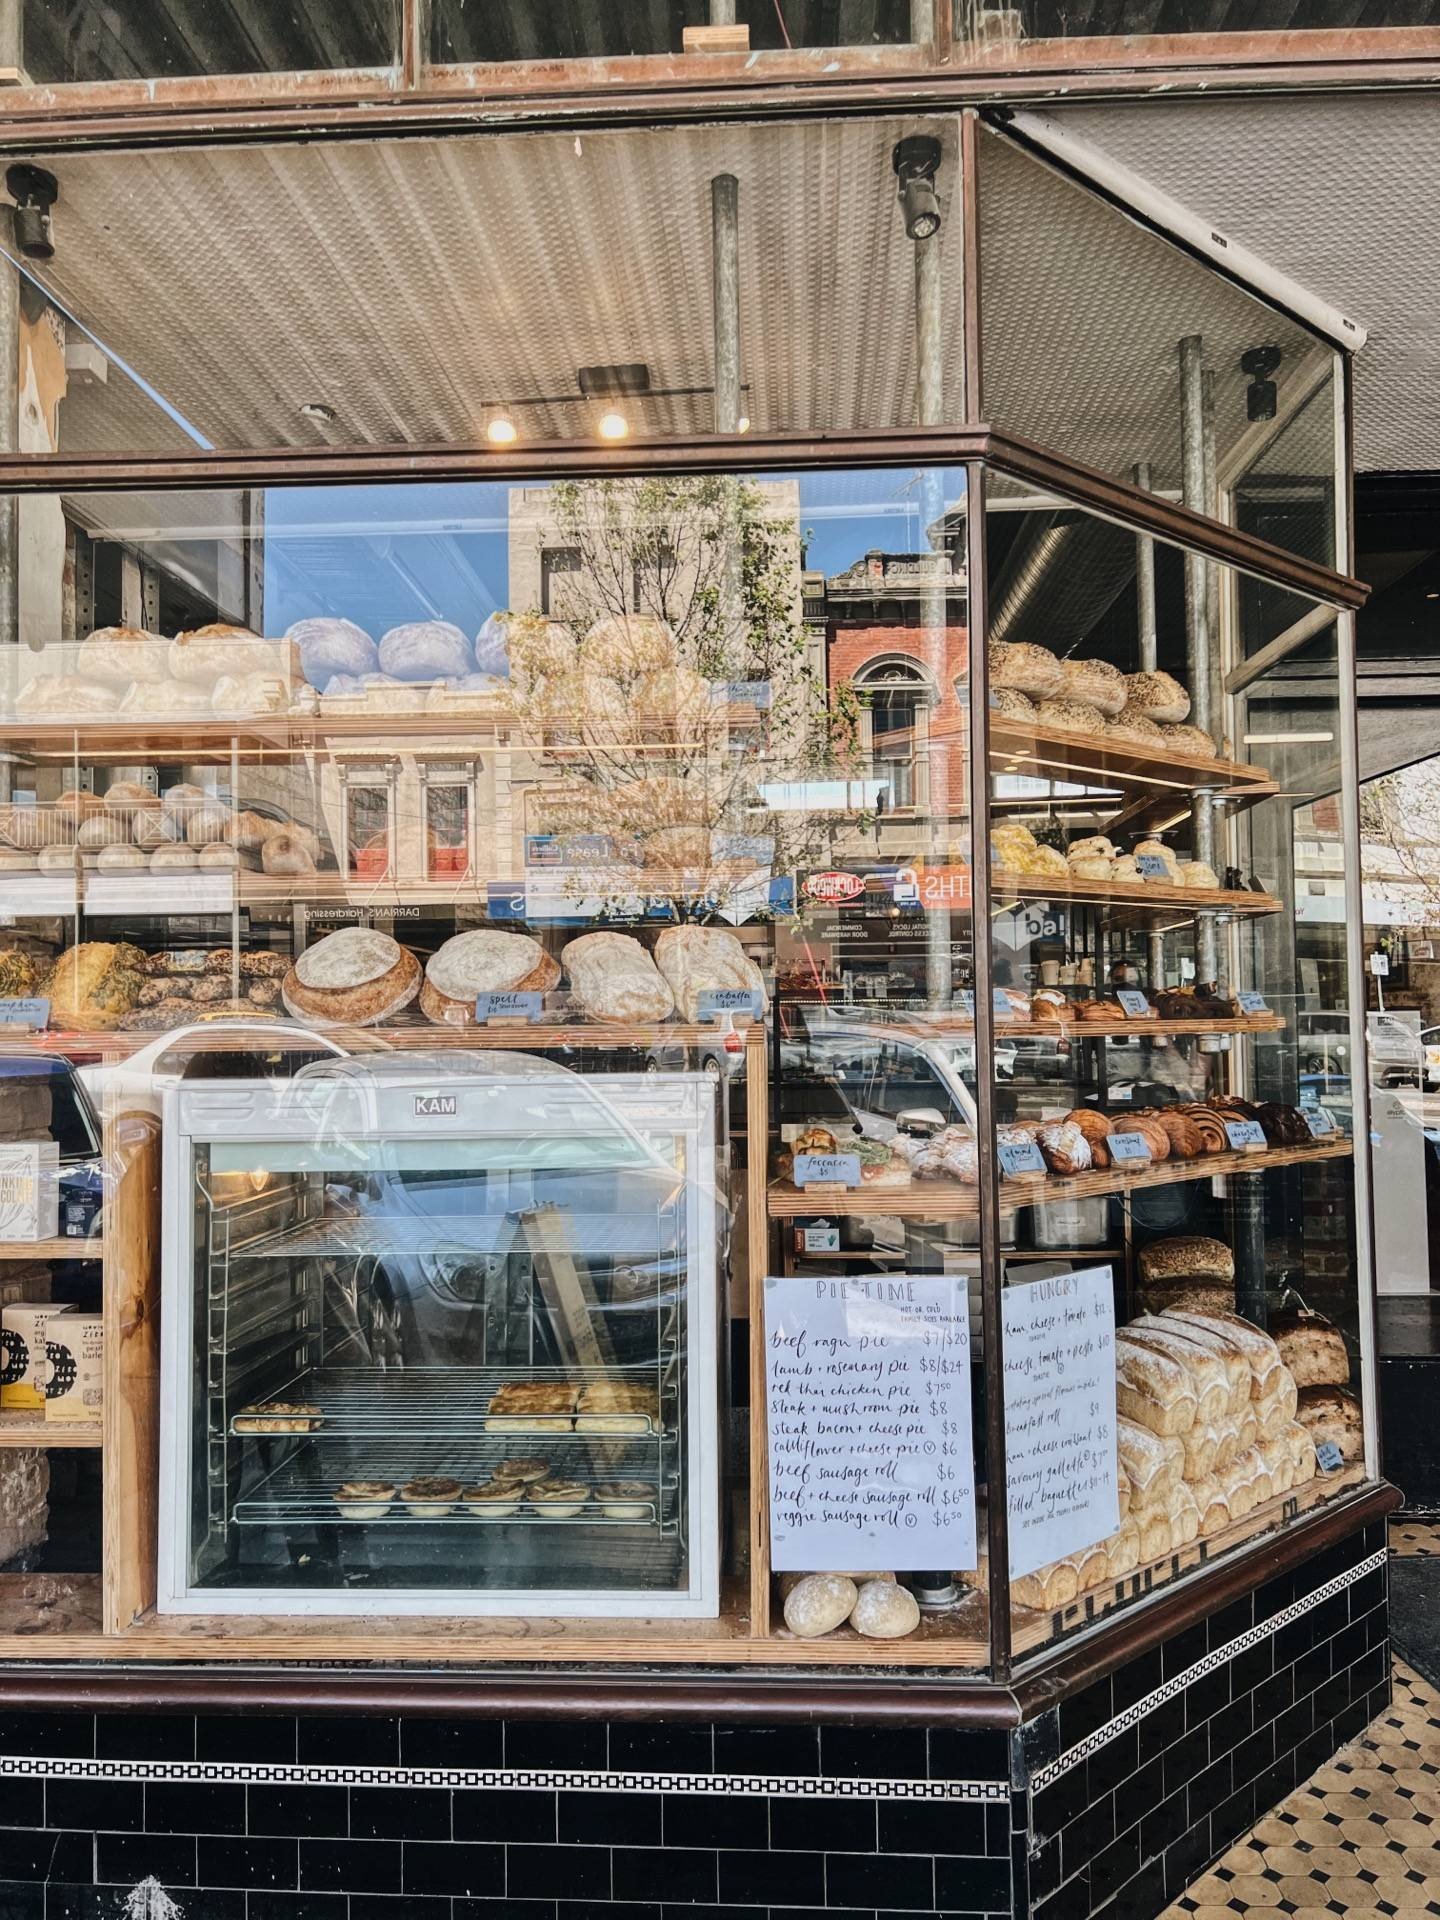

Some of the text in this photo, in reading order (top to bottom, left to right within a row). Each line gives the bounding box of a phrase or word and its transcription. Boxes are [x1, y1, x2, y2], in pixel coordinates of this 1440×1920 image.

[416, 1098, 455, 1113] KAM
[816, 1280, 916, 1302] PIE TIME
[1030, 1277, 1079, 1303] HUNGRY
[771, 1329, 807, 1358] beef
[815, 1334, 851, 1356] ragu
[859, 1335, 889, 1349] pie
[82, 1352, 103, 1360] barle
[772, 1359, 814, 1378] lamb
[826, 1360, 884, 1382] rosemary
[888, 1356, 911, 1375] pie
[919, 1356, 964, 1376] $8/$24
[771, 1380, 792, 1392] red
[830, 1382, 884, 1397] chicken
[888, 1381, 911, 1399] pie
[822, 1401, 893, 1416] mushroom
[899, 1397, 921, 1418] pie
[929, 1400, 948, 1417] $8
[771, 1422, 808, 1436] steak
[868, 1421, 902, 1436] cheese
[906, 1418, 926, 1437] pie
[941, 1420, 958, 1437] $8
[896, 1439, 921, 1459] pie
[942, 1440, 958, 1456] $6
[775, 1460, 955, 1487] beef sausage roll $6
[774, 1484, 806, 1508] beef
[818, 1488, 859, 1504] cheese
[863, 1489, 912, 1510] sausage
[917, 1485, 937, 1506] roll
[776, 1511, 817, 1527] veggie
[823, 1510, 872, 1529] sausage
[874, 1510, 900, 1528] roll
